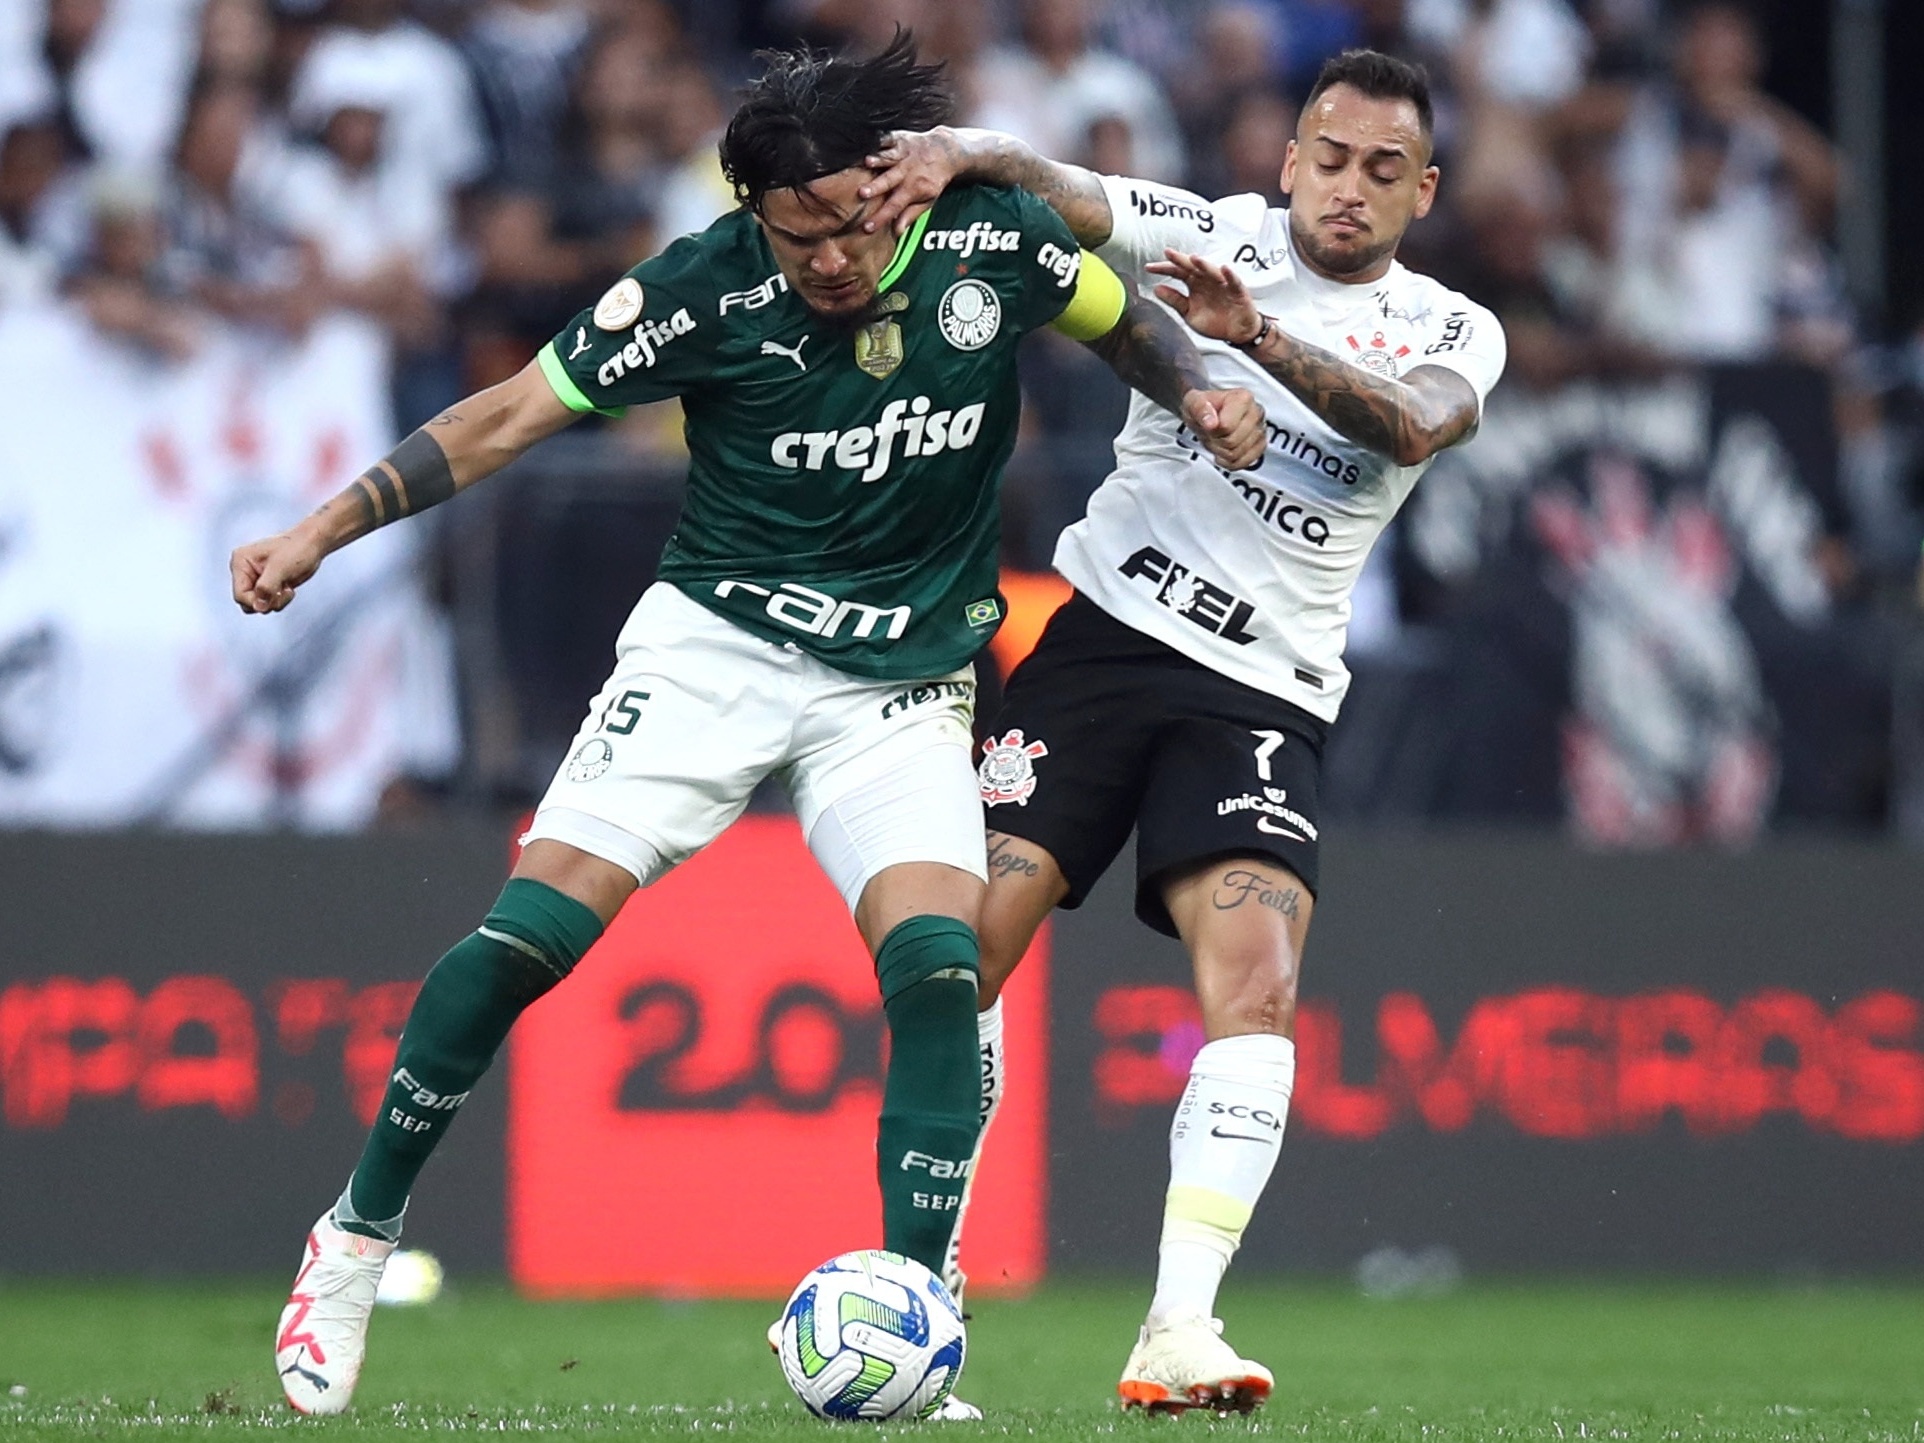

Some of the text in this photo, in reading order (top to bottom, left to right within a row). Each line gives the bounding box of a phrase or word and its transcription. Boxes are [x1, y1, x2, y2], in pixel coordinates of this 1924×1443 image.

[1149, 193, 1214, 233] bmg
[923, 222, 1021, 258] crefisa
[597, 307, 697, 387] crefisa
[943, 304, 996, 346] PALMEIRAS
[771, 395, 986, 482] crefisa
[1266, 420, 1361, 486] minas
[1250, 730, 1285, 781] 7
[1213, 869, 1301, 921] Faith
[614, 979, 888, 1117] 2.0
[389, 1106, 431, 1133] SEP
[912, 1191, 959, 1211] SEP
